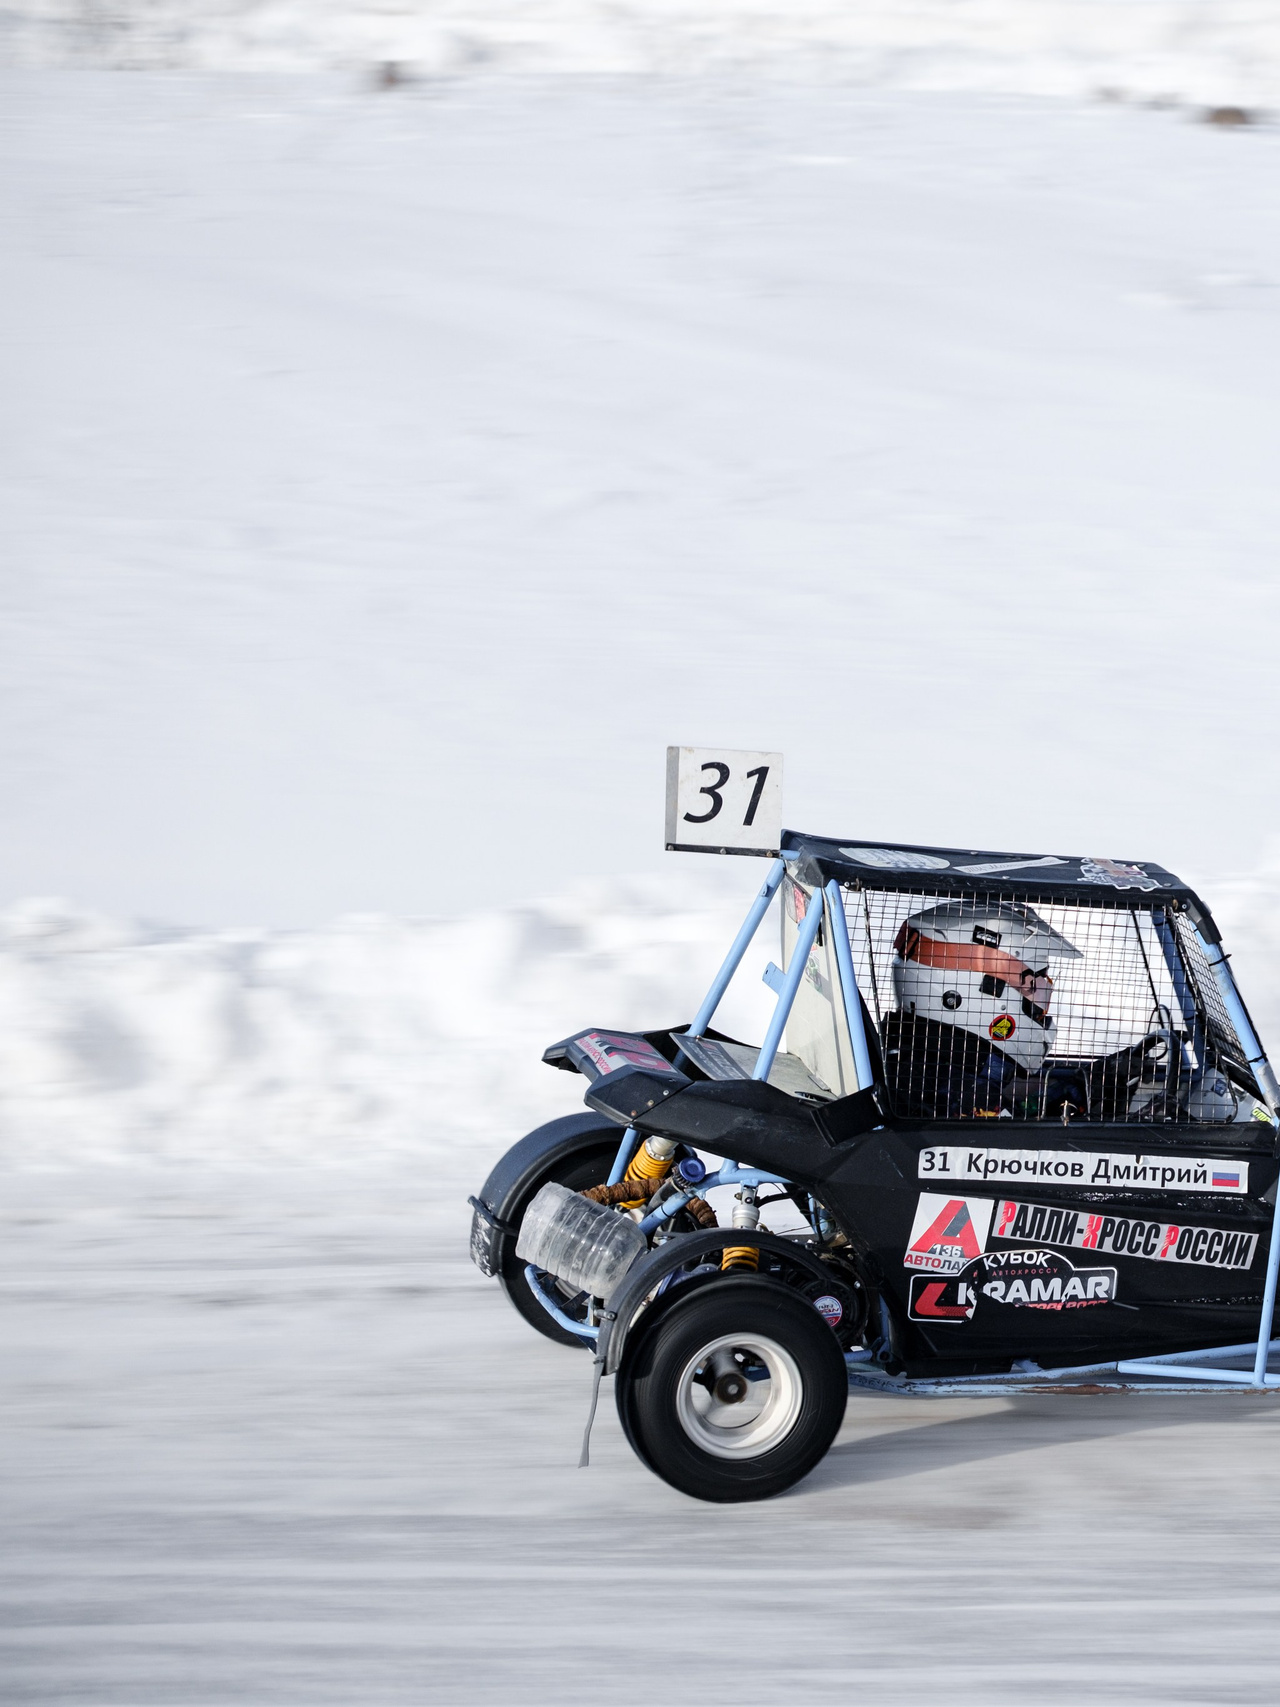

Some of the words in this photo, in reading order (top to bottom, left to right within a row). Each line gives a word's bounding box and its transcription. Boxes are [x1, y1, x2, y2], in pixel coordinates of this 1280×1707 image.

[682, 761, 770, 827] 31
[922, 1151, 951, 1172] 31
[967, 1152, 1084, 1179] Крючков
[1091, 1158, 1208, 1188] Дмитрий
[932, 1243, 962, 1258] 136
[998, 1201, 1161, 1257] РАЛЛИ-КРОСС
[1160, 1225, 1254, 1268] РОССИИ
[982, 1251, 1052, 1271] КУБОК
